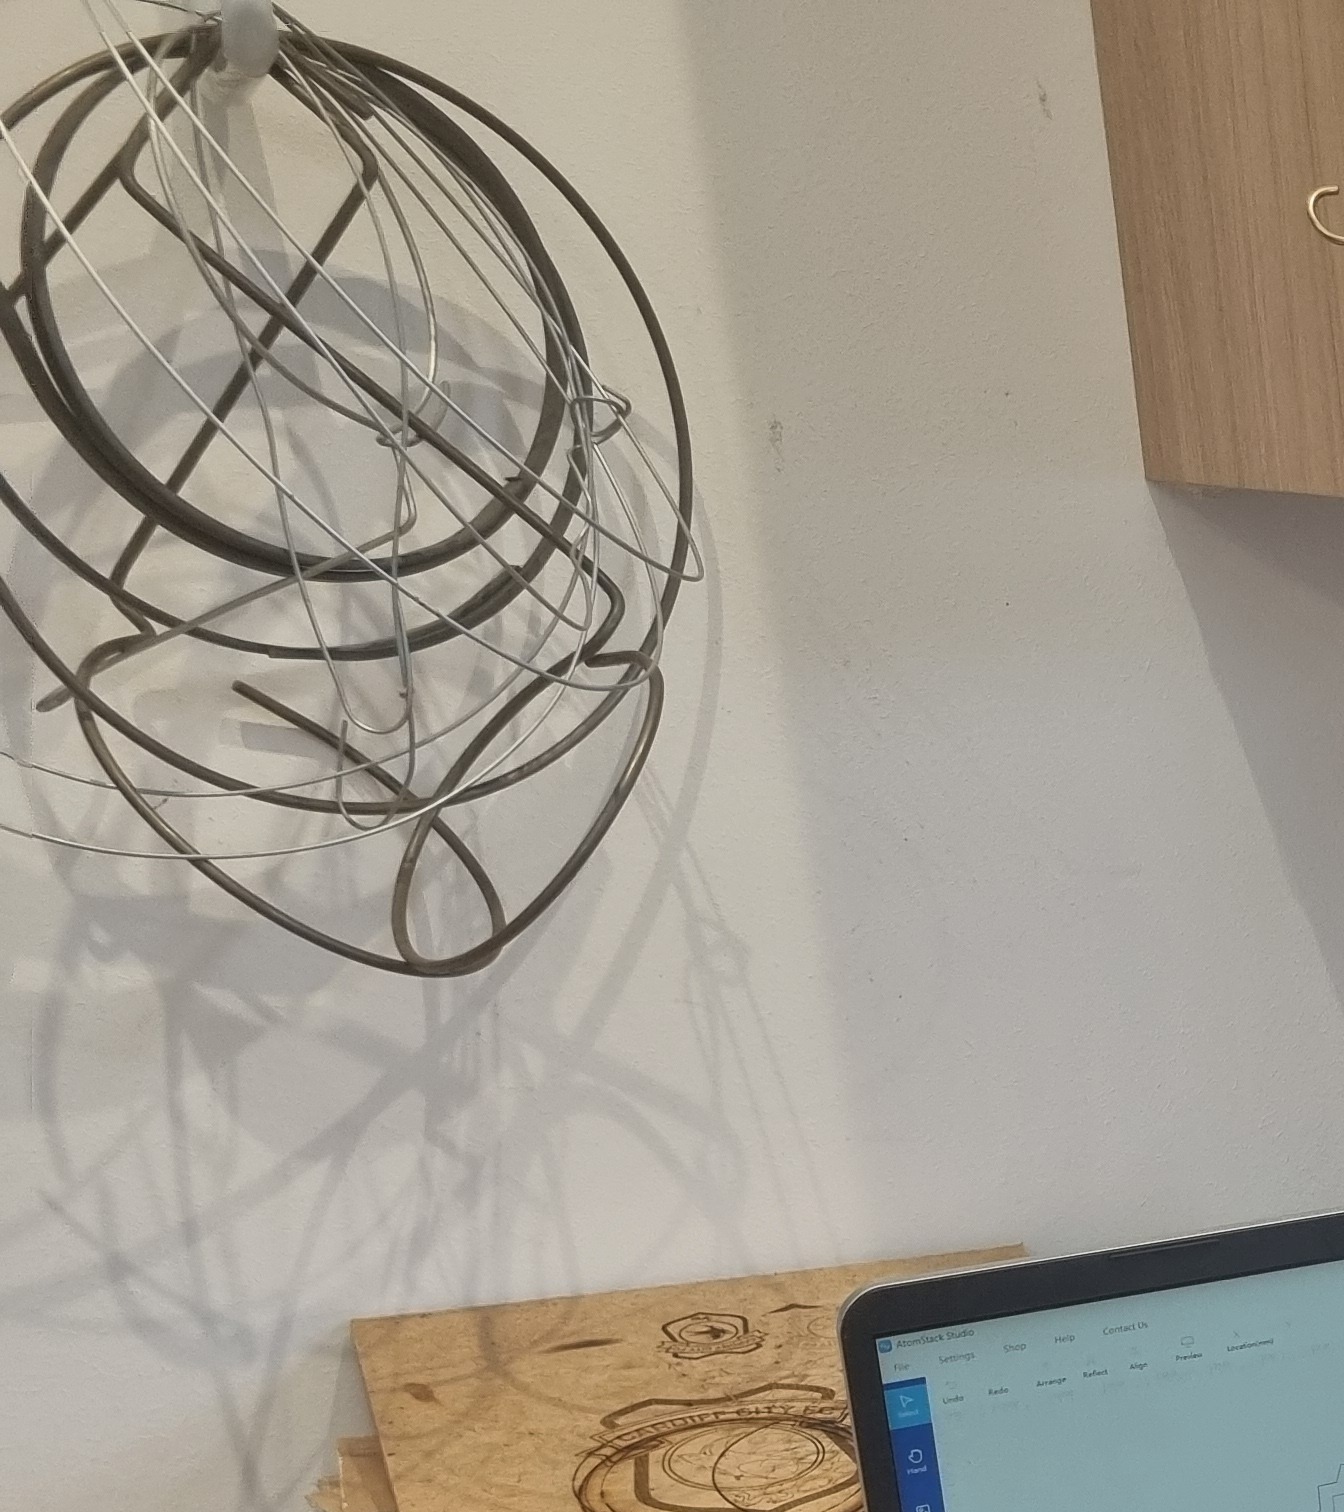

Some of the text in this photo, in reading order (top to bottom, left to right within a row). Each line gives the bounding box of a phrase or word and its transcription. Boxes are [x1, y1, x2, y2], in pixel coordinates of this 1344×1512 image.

[894, 1320, 1149, 1373] File Settings Shop Help Contact Us
[896, 1328, 975, 1350] AtomStack Studio
[942, 1393, 965, 1405] Undo
[988, 1386, 1010, 1397] Redo
[1035, 1375, 1068, 1388] Arrange
[1082, 1368, 1109, 1380] Reflect
[1129, 1360, 1149, 1372] Align
[1175, 1351, 1203, 1363] Preview
[618, 1410, 726, 1443] CARDIFF
[736, 1405, 796, 1417] CITY
[907, 1466, 928, 1475] Hand
